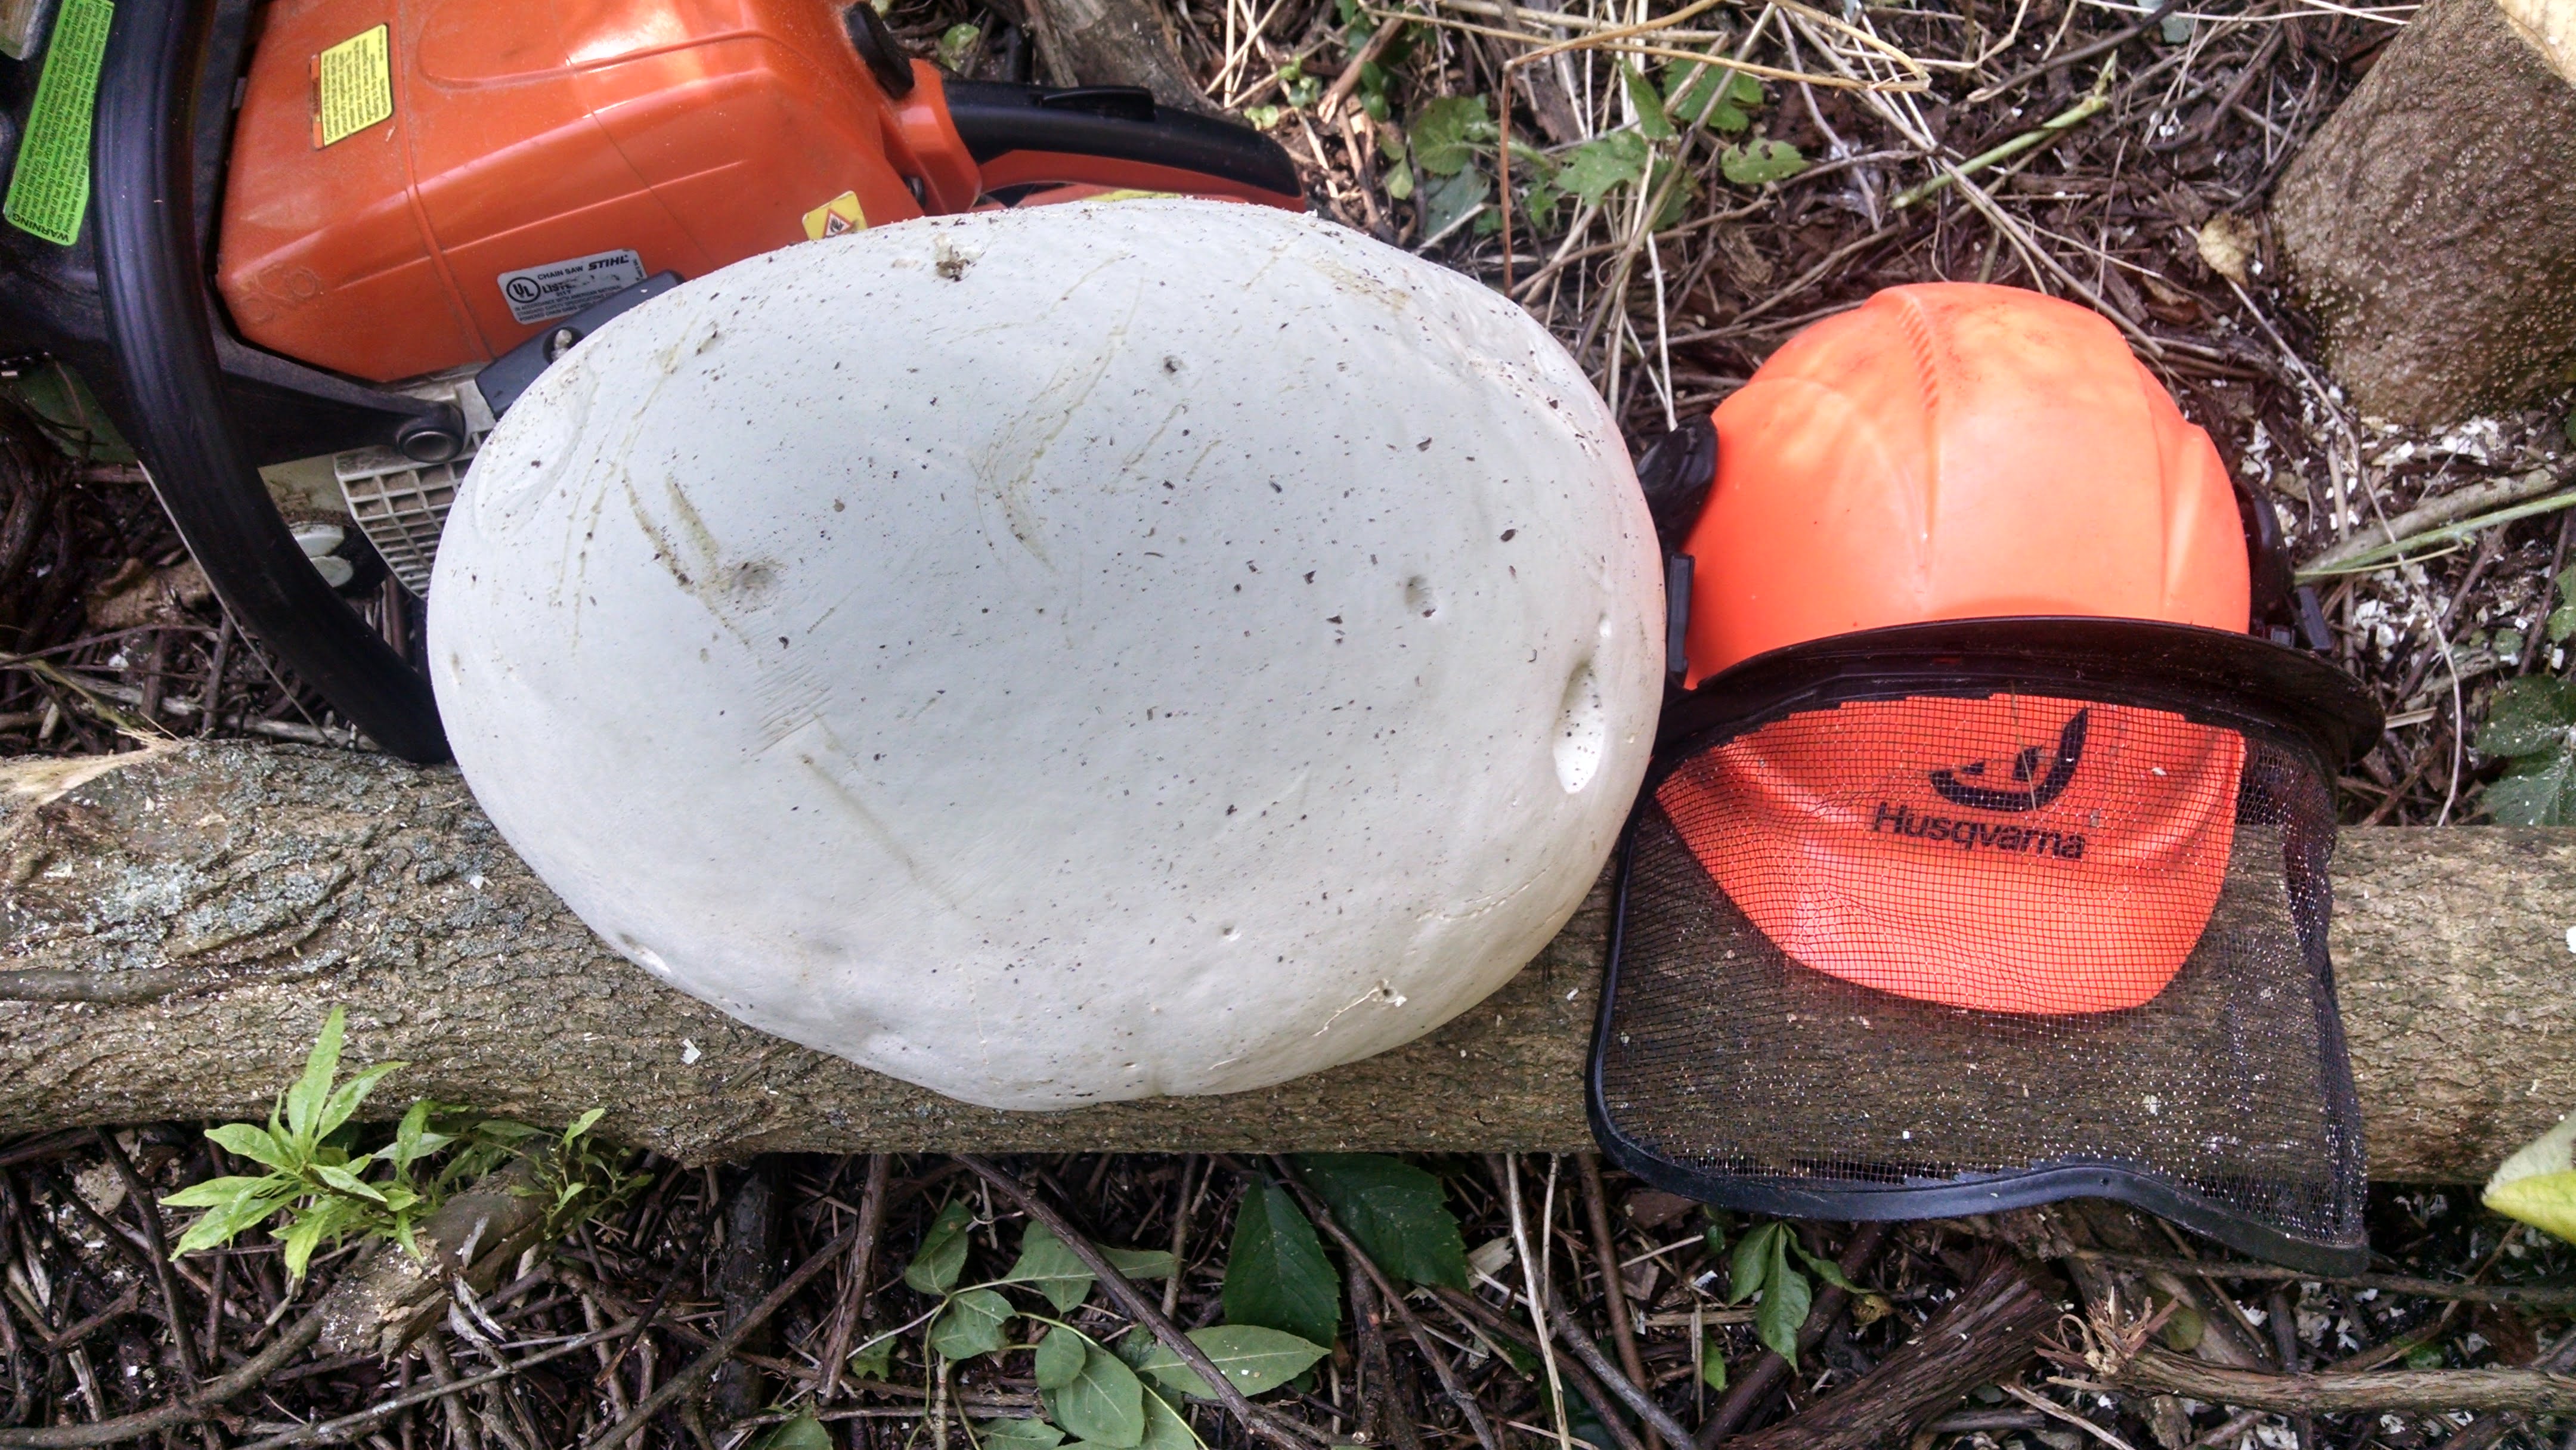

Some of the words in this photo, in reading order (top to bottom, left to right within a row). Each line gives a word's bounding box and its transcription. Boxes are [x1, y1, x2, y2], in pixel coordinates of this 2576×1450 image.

[537, 270, 564, 280] CHAIN
[565, 265, 584, 275] SAW
[588, 255, 630, 271] STIHL
[512, 283, 535, 298] UL
[1874, 801, 2086, 859] Husqvarna
